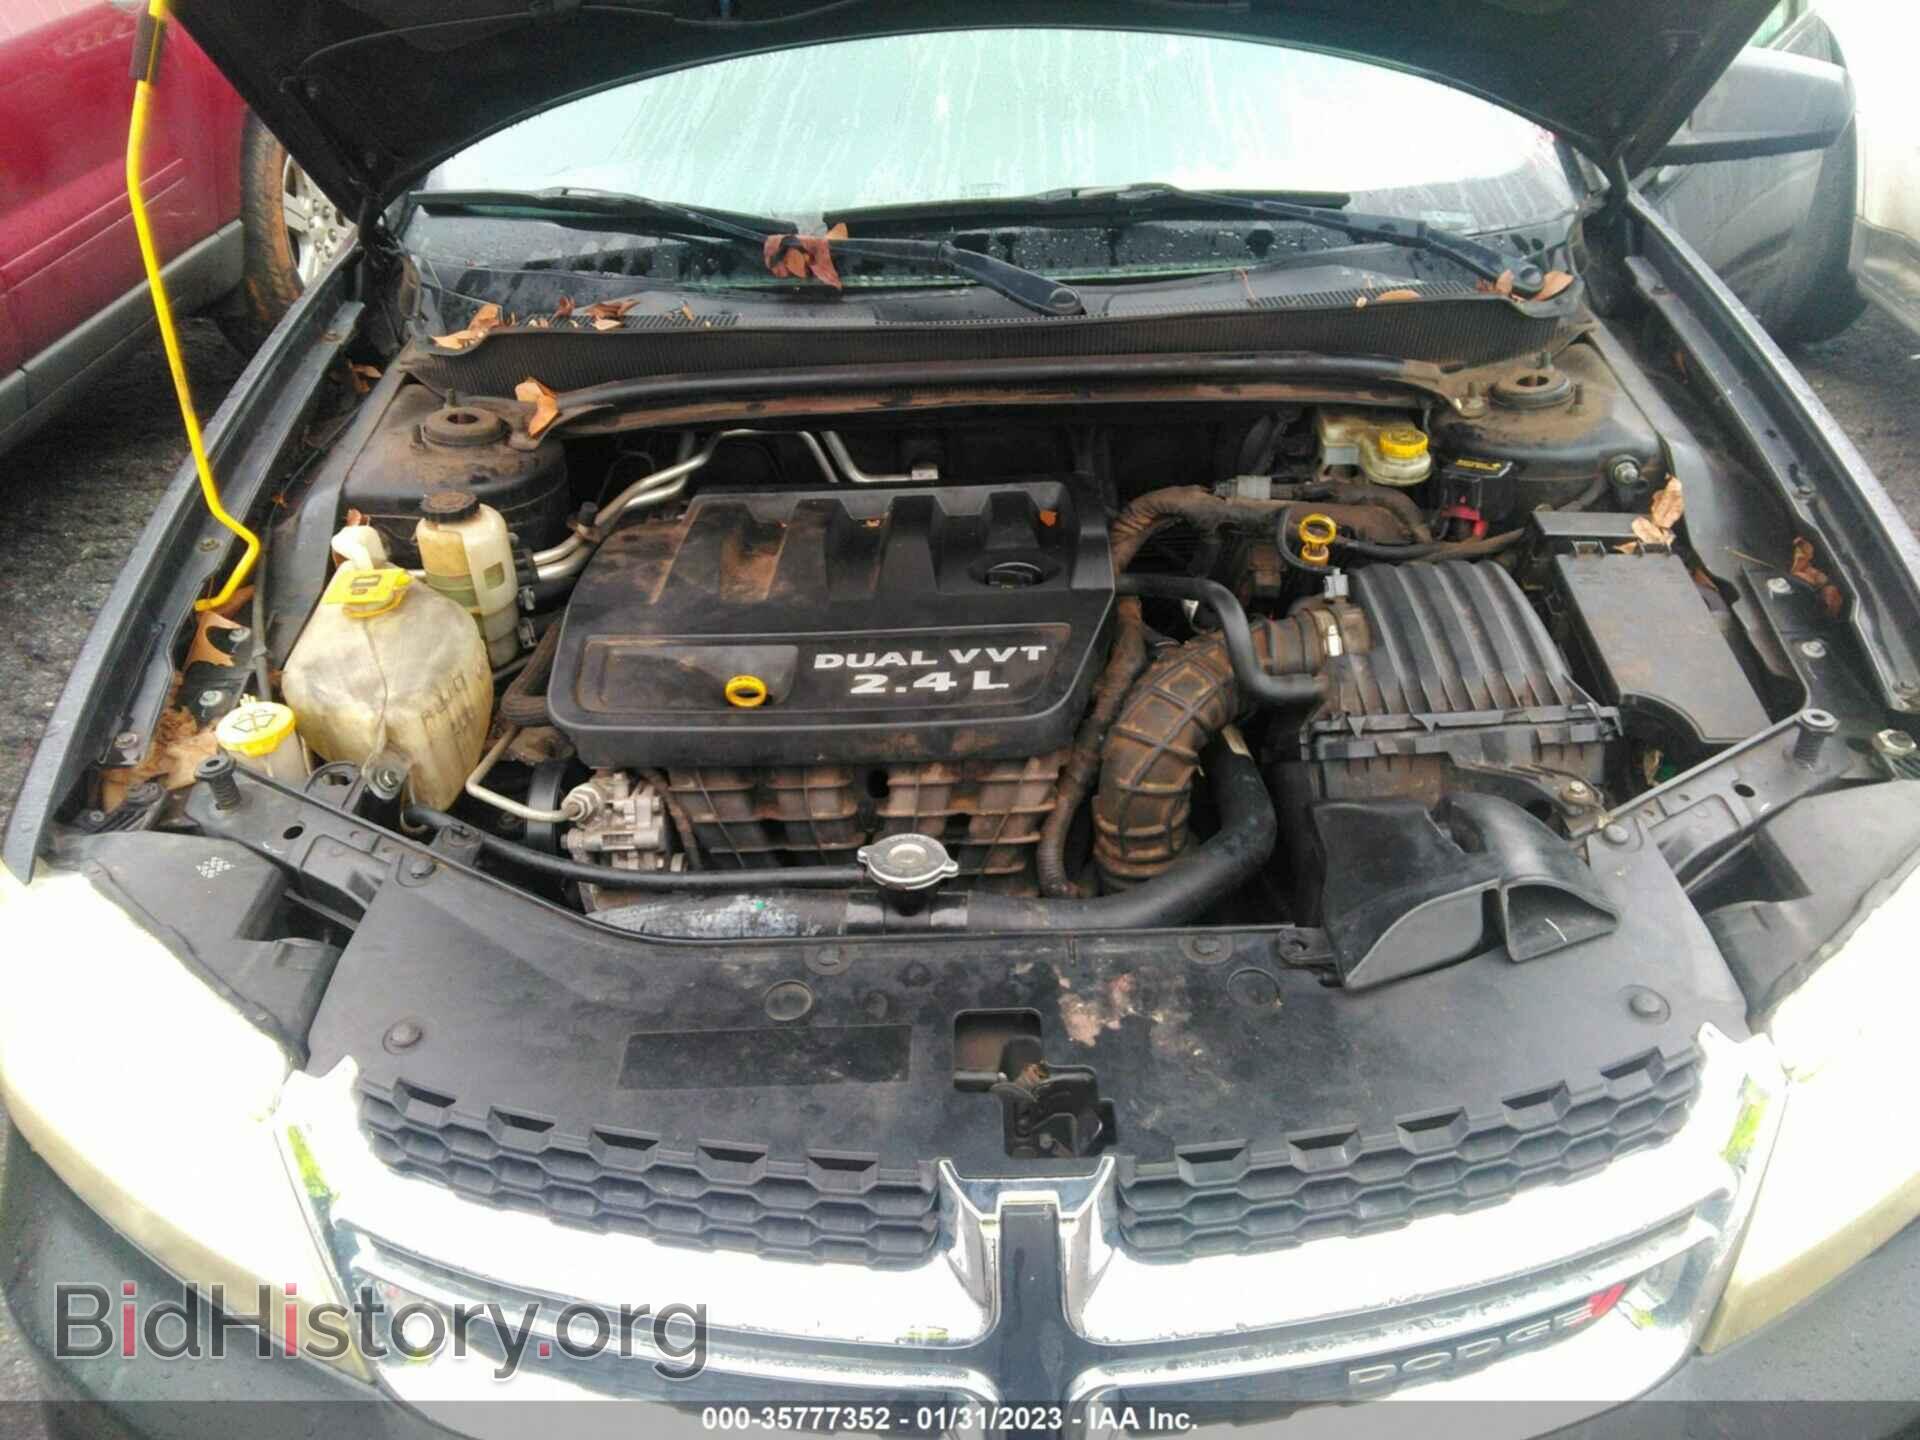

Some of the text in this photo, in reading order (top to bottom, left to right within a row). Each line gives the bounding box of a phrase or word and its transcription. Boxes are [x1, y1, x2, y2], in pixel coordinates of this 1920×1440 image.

[814, 646, 1047, 669] DUAL VVT
[1348, 1303, 1594, 1385] DODGE
